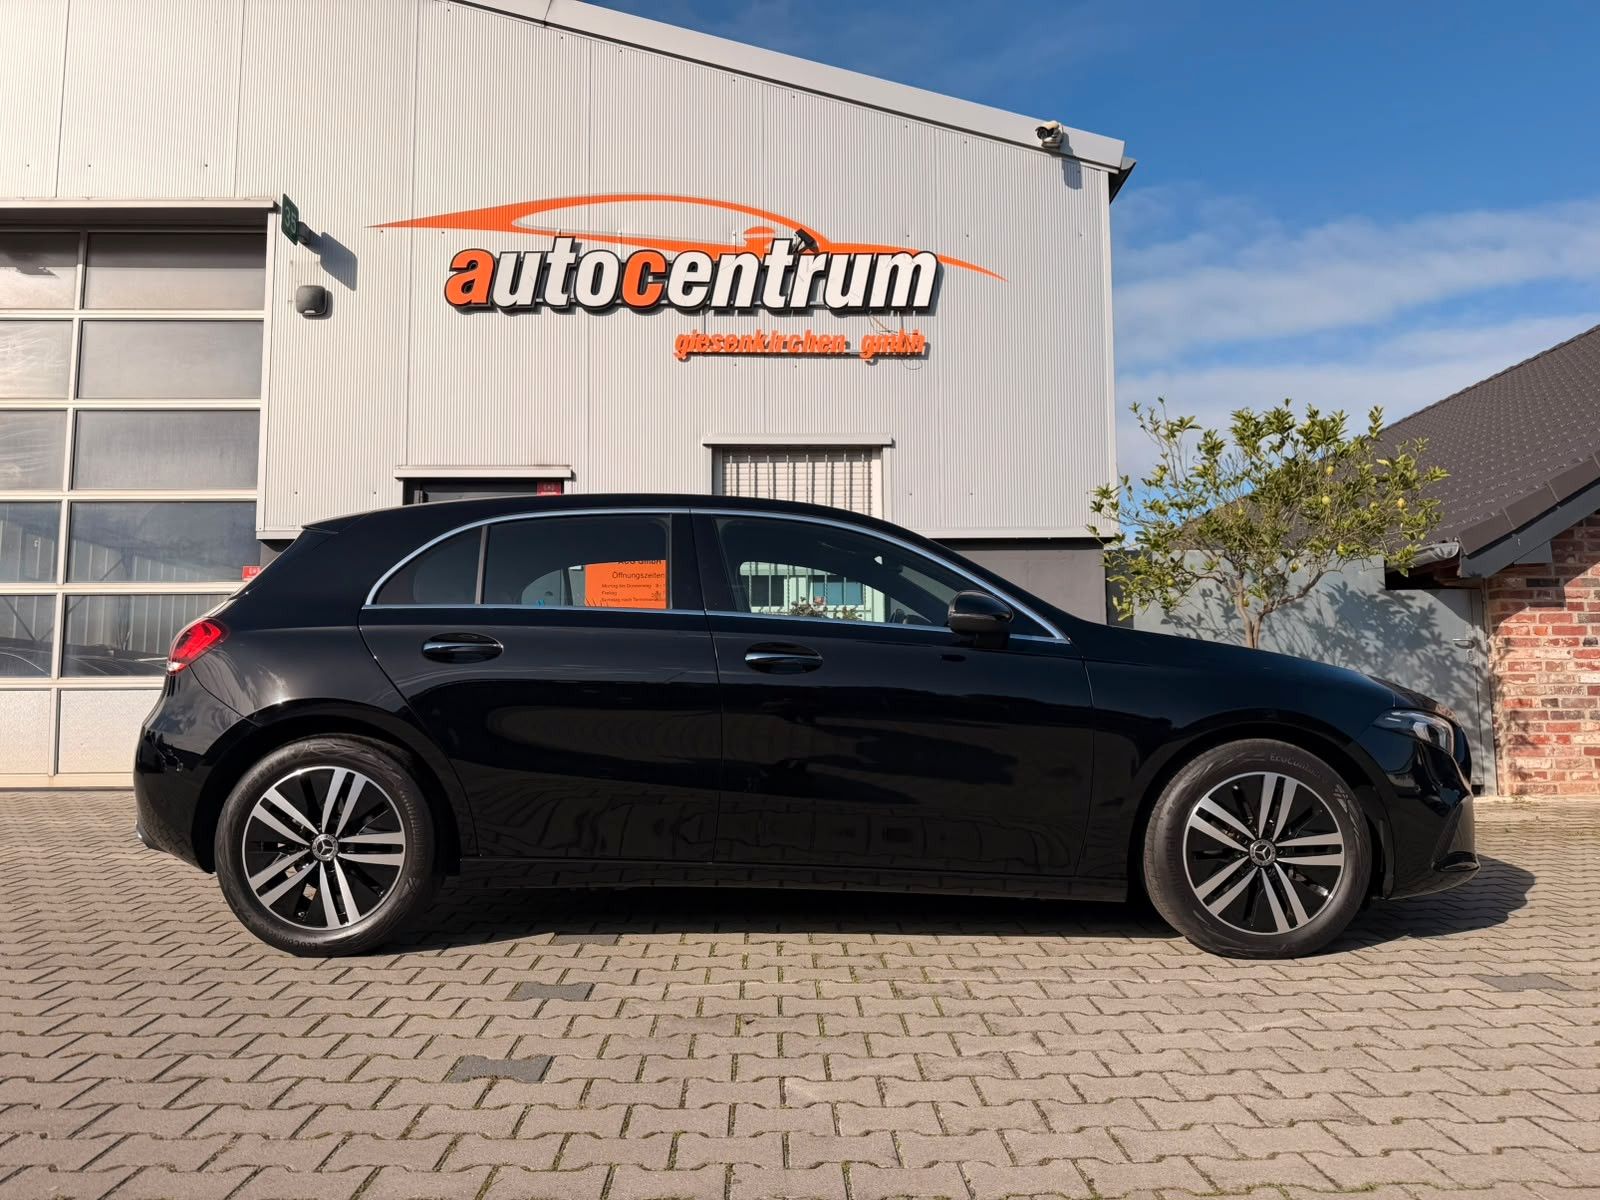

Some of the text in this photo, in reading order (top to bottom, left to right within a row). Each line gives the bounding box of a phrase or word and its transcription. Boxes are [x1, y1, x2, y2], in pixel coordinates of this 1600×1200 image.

[284, 205, 297, 234] 35
[444, 235, 940, 311] autocentrum
[673, 329, 847, 360] giesenkirchen
